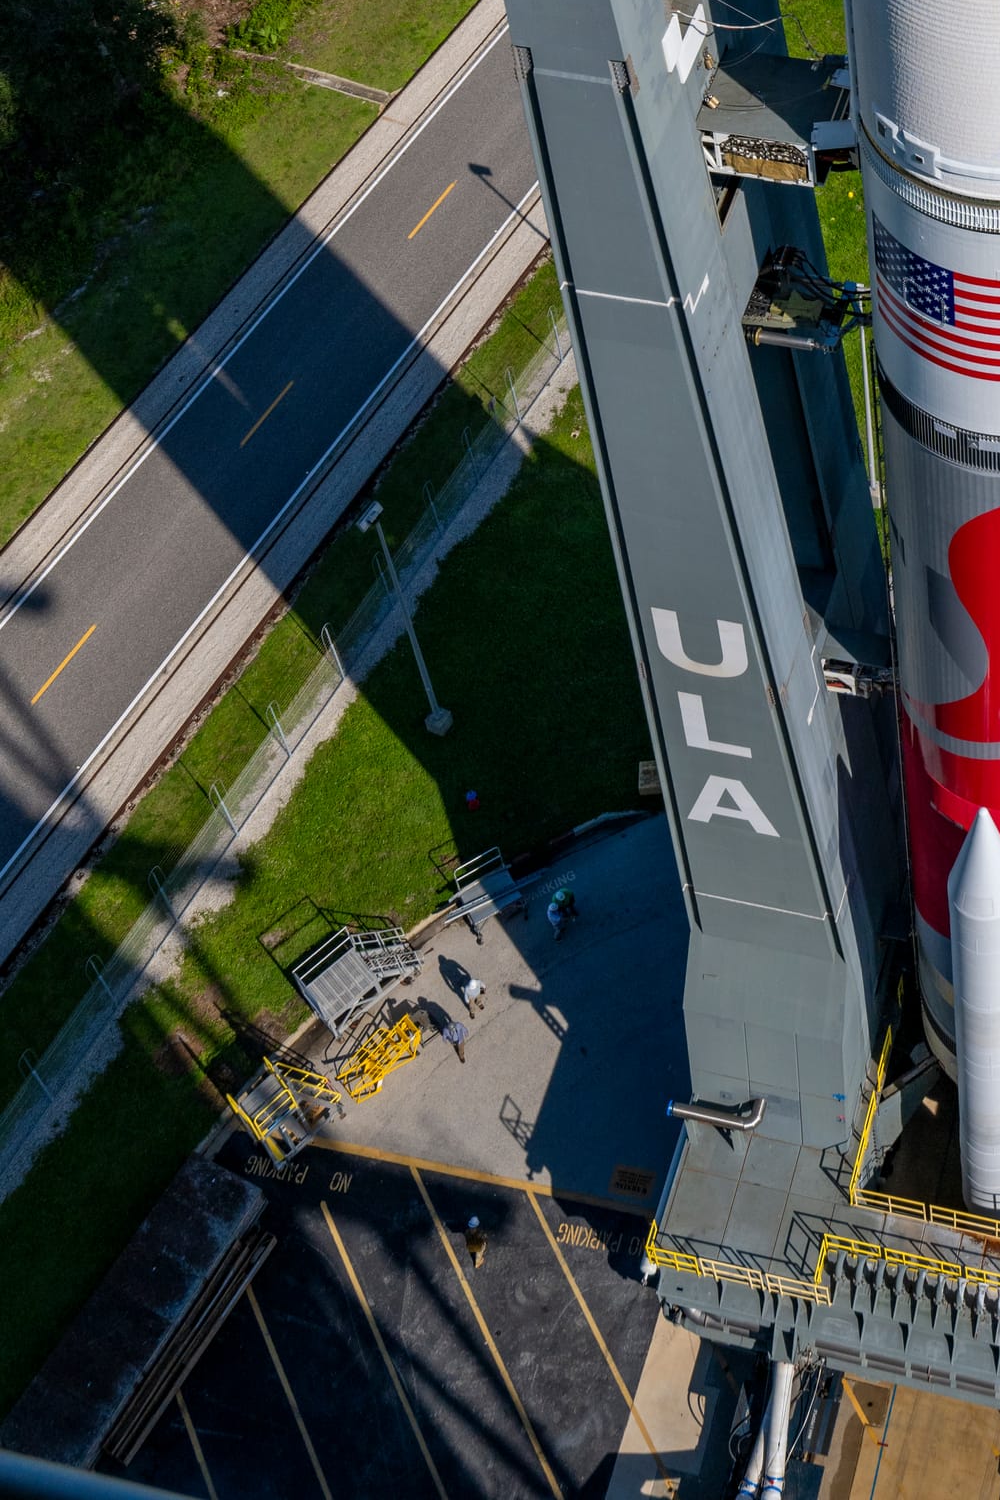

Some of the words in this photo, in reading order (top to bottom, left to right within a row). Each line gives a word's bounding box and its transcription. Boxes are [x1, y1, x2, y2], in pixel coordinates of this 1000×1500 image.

[650, 606, 781, 838] ULA
[329, 1171, 353, 1194] NO
[556, 1223, 623, 1253] PARKING
